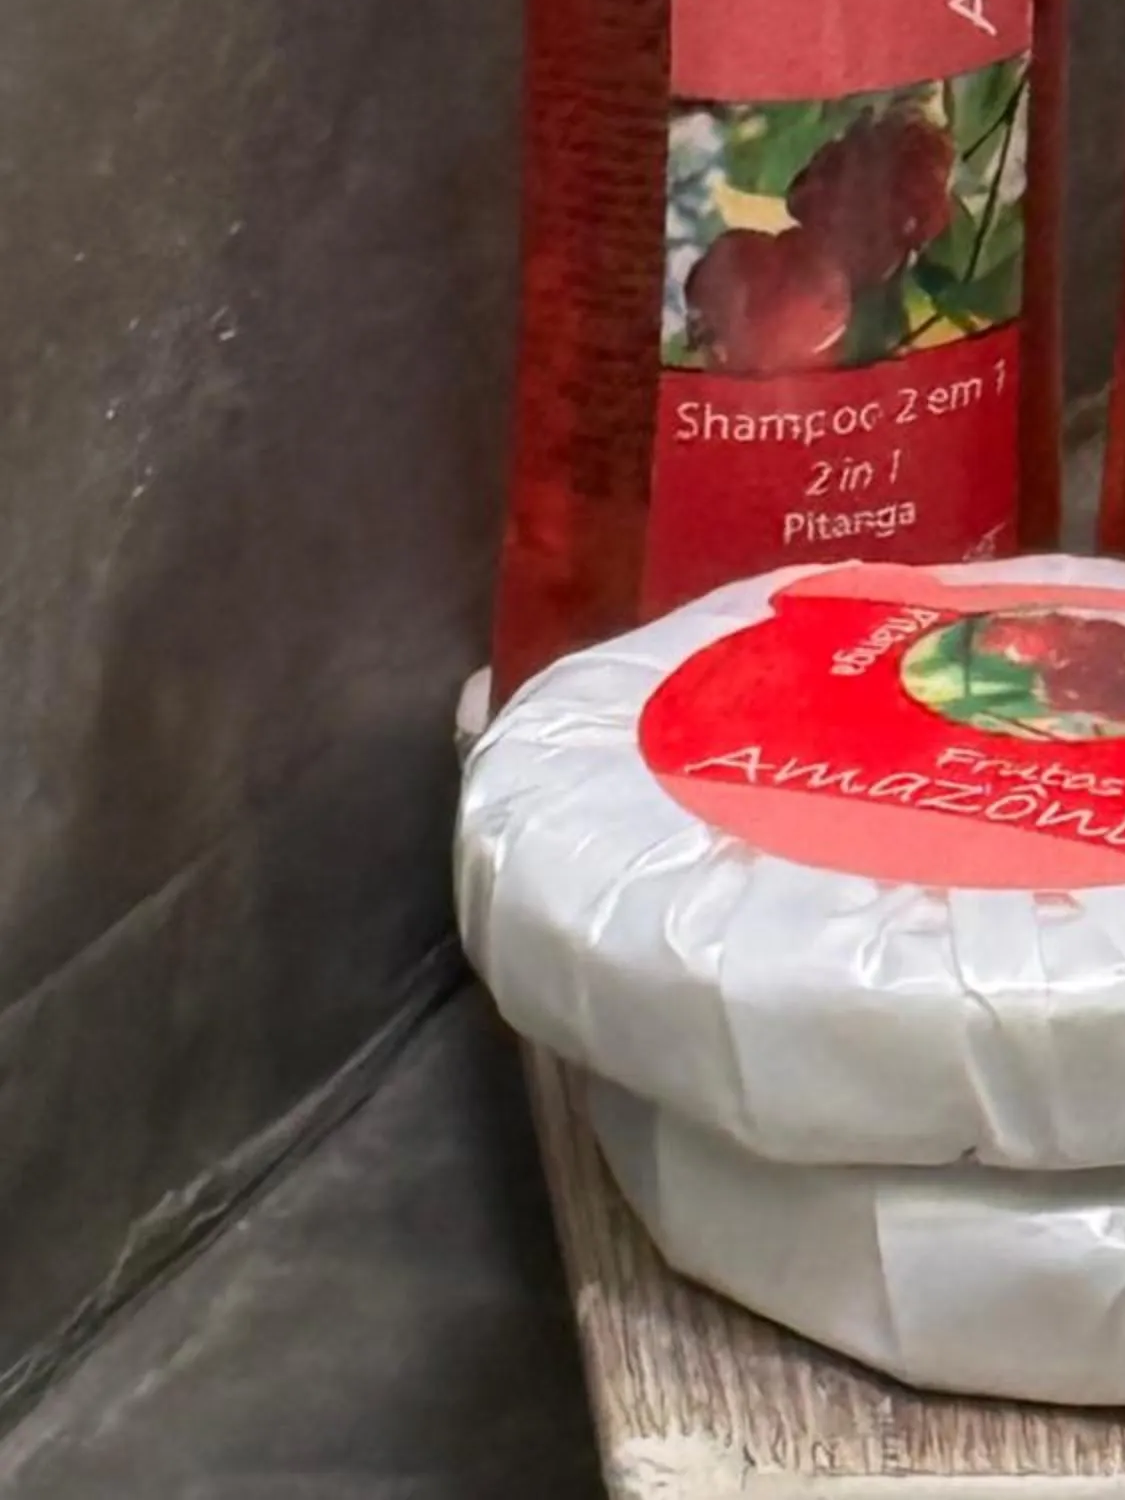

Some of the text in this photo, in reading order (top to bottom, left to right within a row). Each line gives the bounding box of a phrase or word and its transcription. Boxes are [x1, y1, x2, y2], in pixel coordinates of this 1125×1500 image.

[675, 359, 1006, 445] Shampoo 2 em 1
[806, 449, 902, 497] 2 in 1
[783, 501, 917, 545] Pitanga
[935, 747, 1125, 798] Frutos
